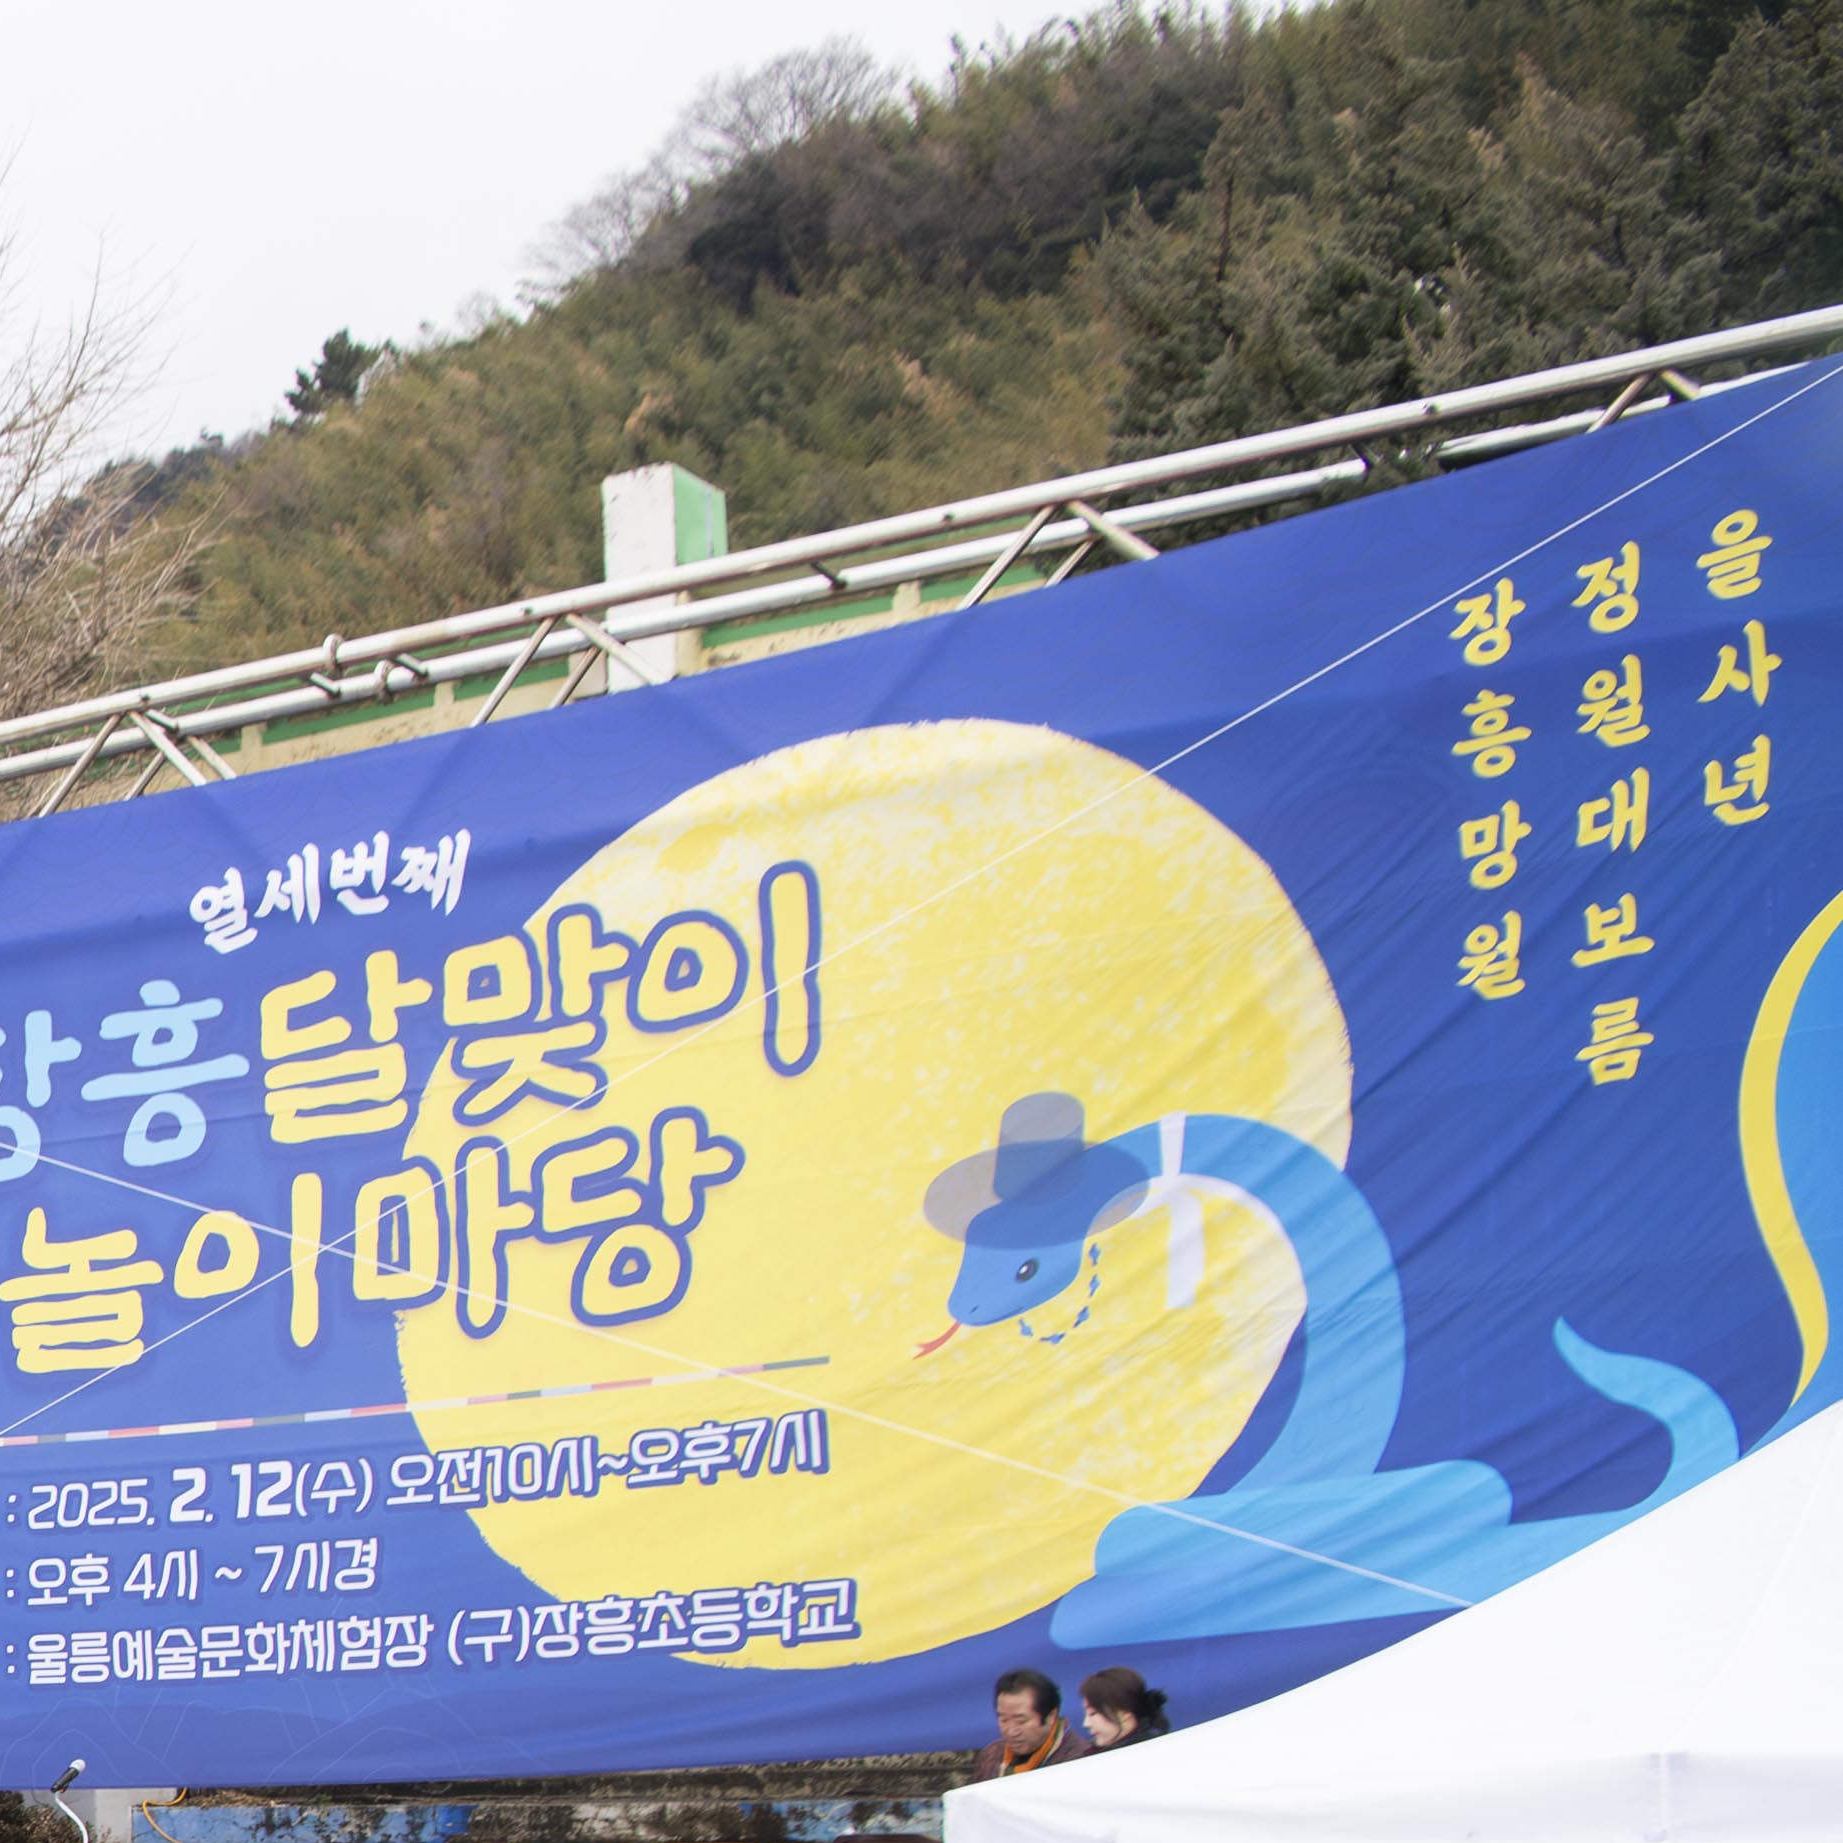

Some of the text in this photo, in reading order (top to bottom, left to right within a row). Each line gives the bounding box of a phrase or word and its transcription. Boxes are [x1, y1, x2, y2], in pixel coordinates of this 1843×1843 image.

[1696, 509, 1782, 826] 을사년
[1448, 577, 1532, 1000] 장흥망월
[1571, 540, 1655, 1086] 정월대보름
[190, 829, 470, 954] 열세번째
[28, 1478, 155, 1530] 2025.
[231, 1458, 373, 1519] 12(수)
[27, 1553, 110, 1606] 오후
[122, 1549, 198, 1600] 4시
[254, 1538, 379, 1593] 7시경
[27, 1614, 434, 1685] 울릉예술문화체험장
